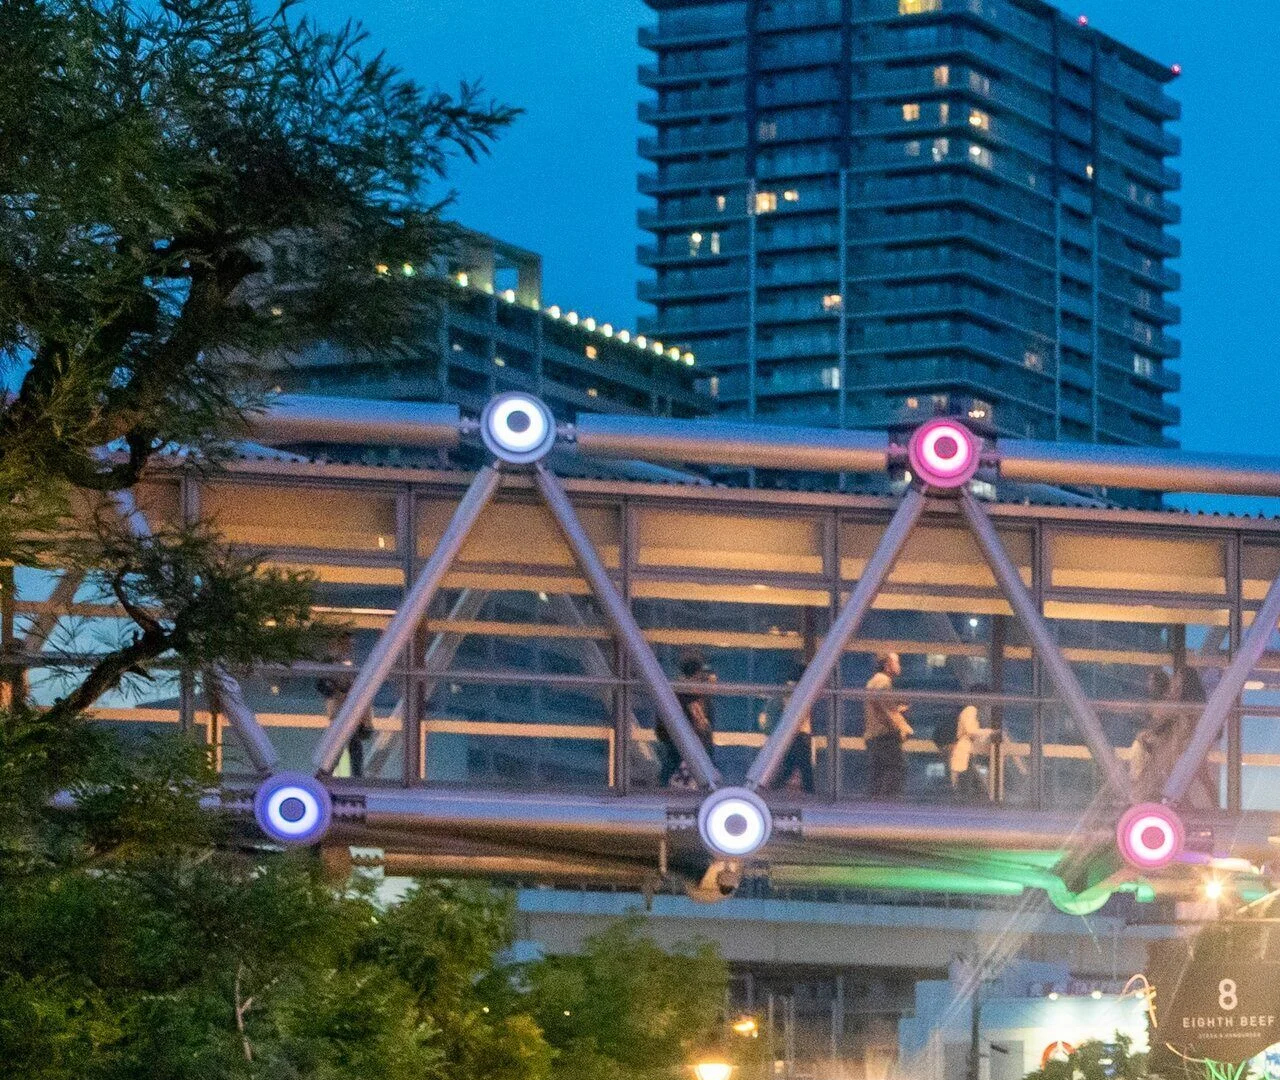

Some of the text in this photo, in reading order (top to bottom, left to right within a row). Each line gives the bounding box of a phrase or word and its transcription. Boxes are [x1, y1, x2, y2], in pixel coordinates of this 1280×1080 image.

[1218, 978, 1238, 1011] 8
[1182, 1015, 1275, 1028] EIGHTH BEEF
